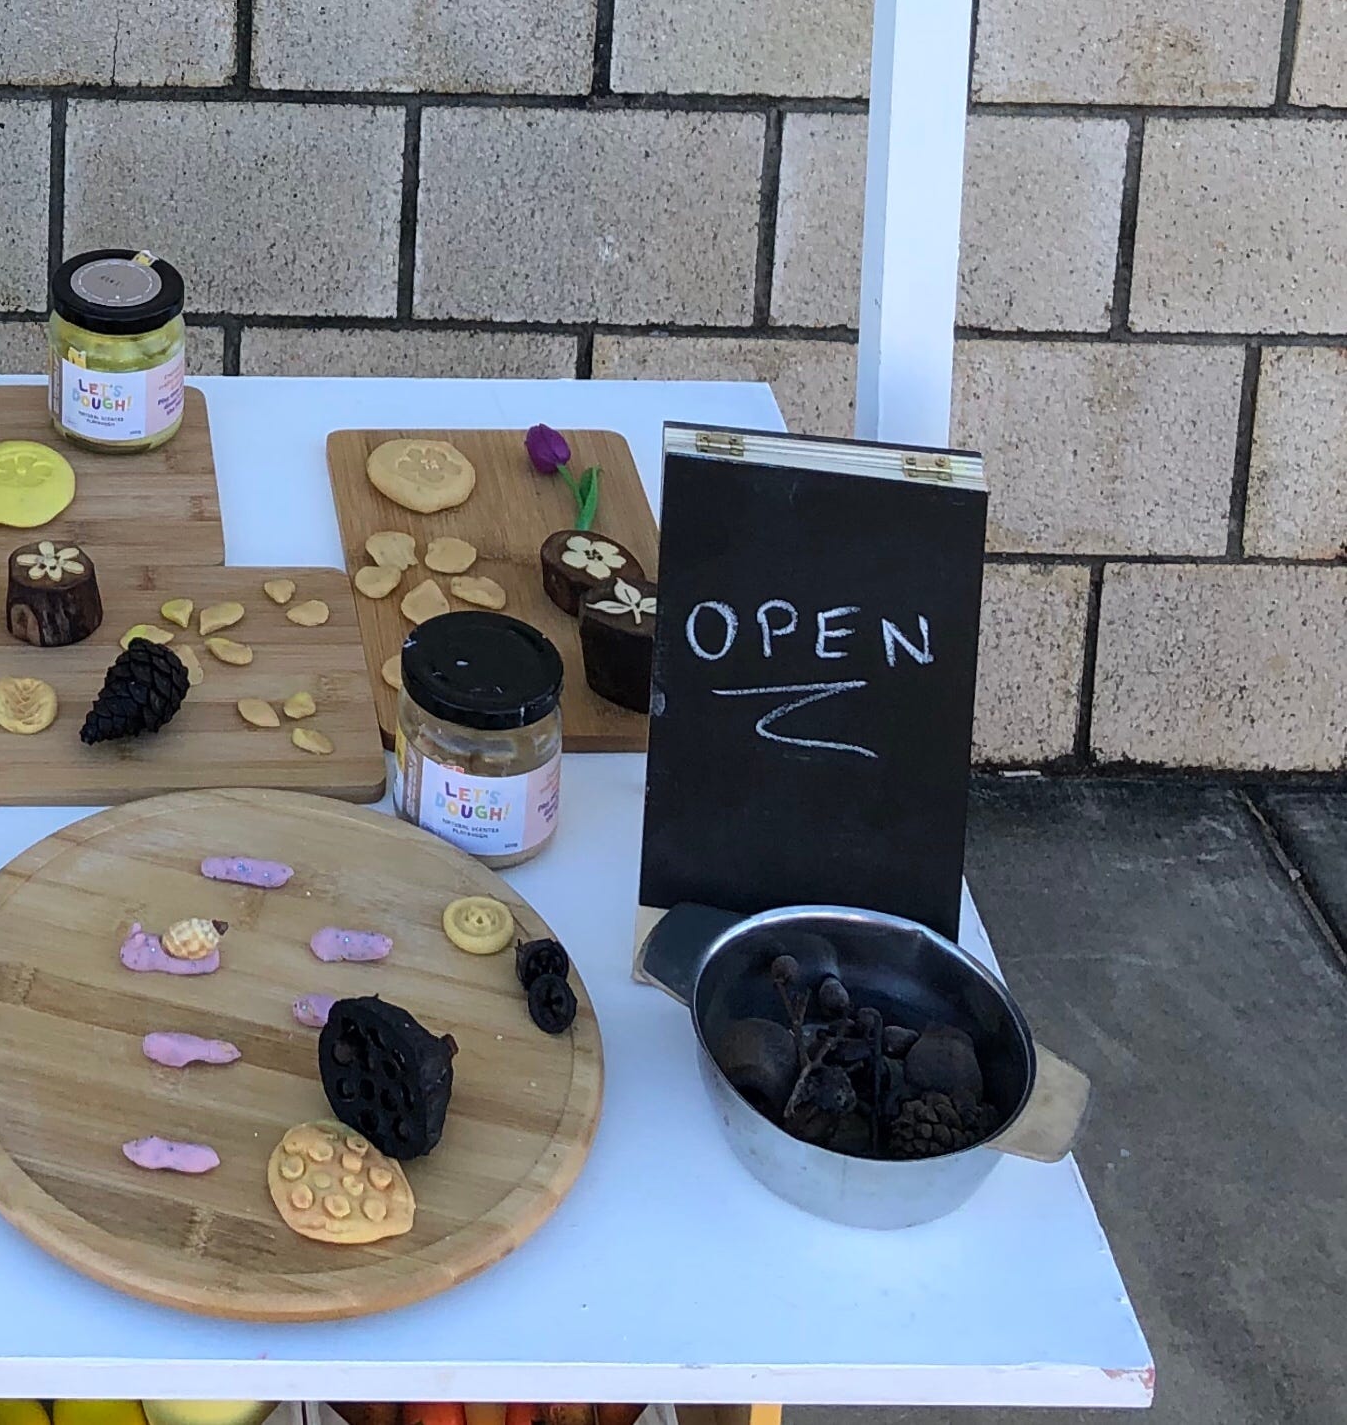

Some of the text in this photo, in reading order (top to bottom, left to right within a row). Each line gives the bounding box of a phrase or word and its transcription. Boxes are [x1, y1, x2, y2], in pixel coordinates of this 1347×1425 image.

[72, 388, 133, 412] DOUGH!
[78, 378, 124, 398] LET'S
[684, 598, 935, 668] OPEN
[445, 781, 502, 804] LET'S
[434, 791, 511, 822] DOUGH!
